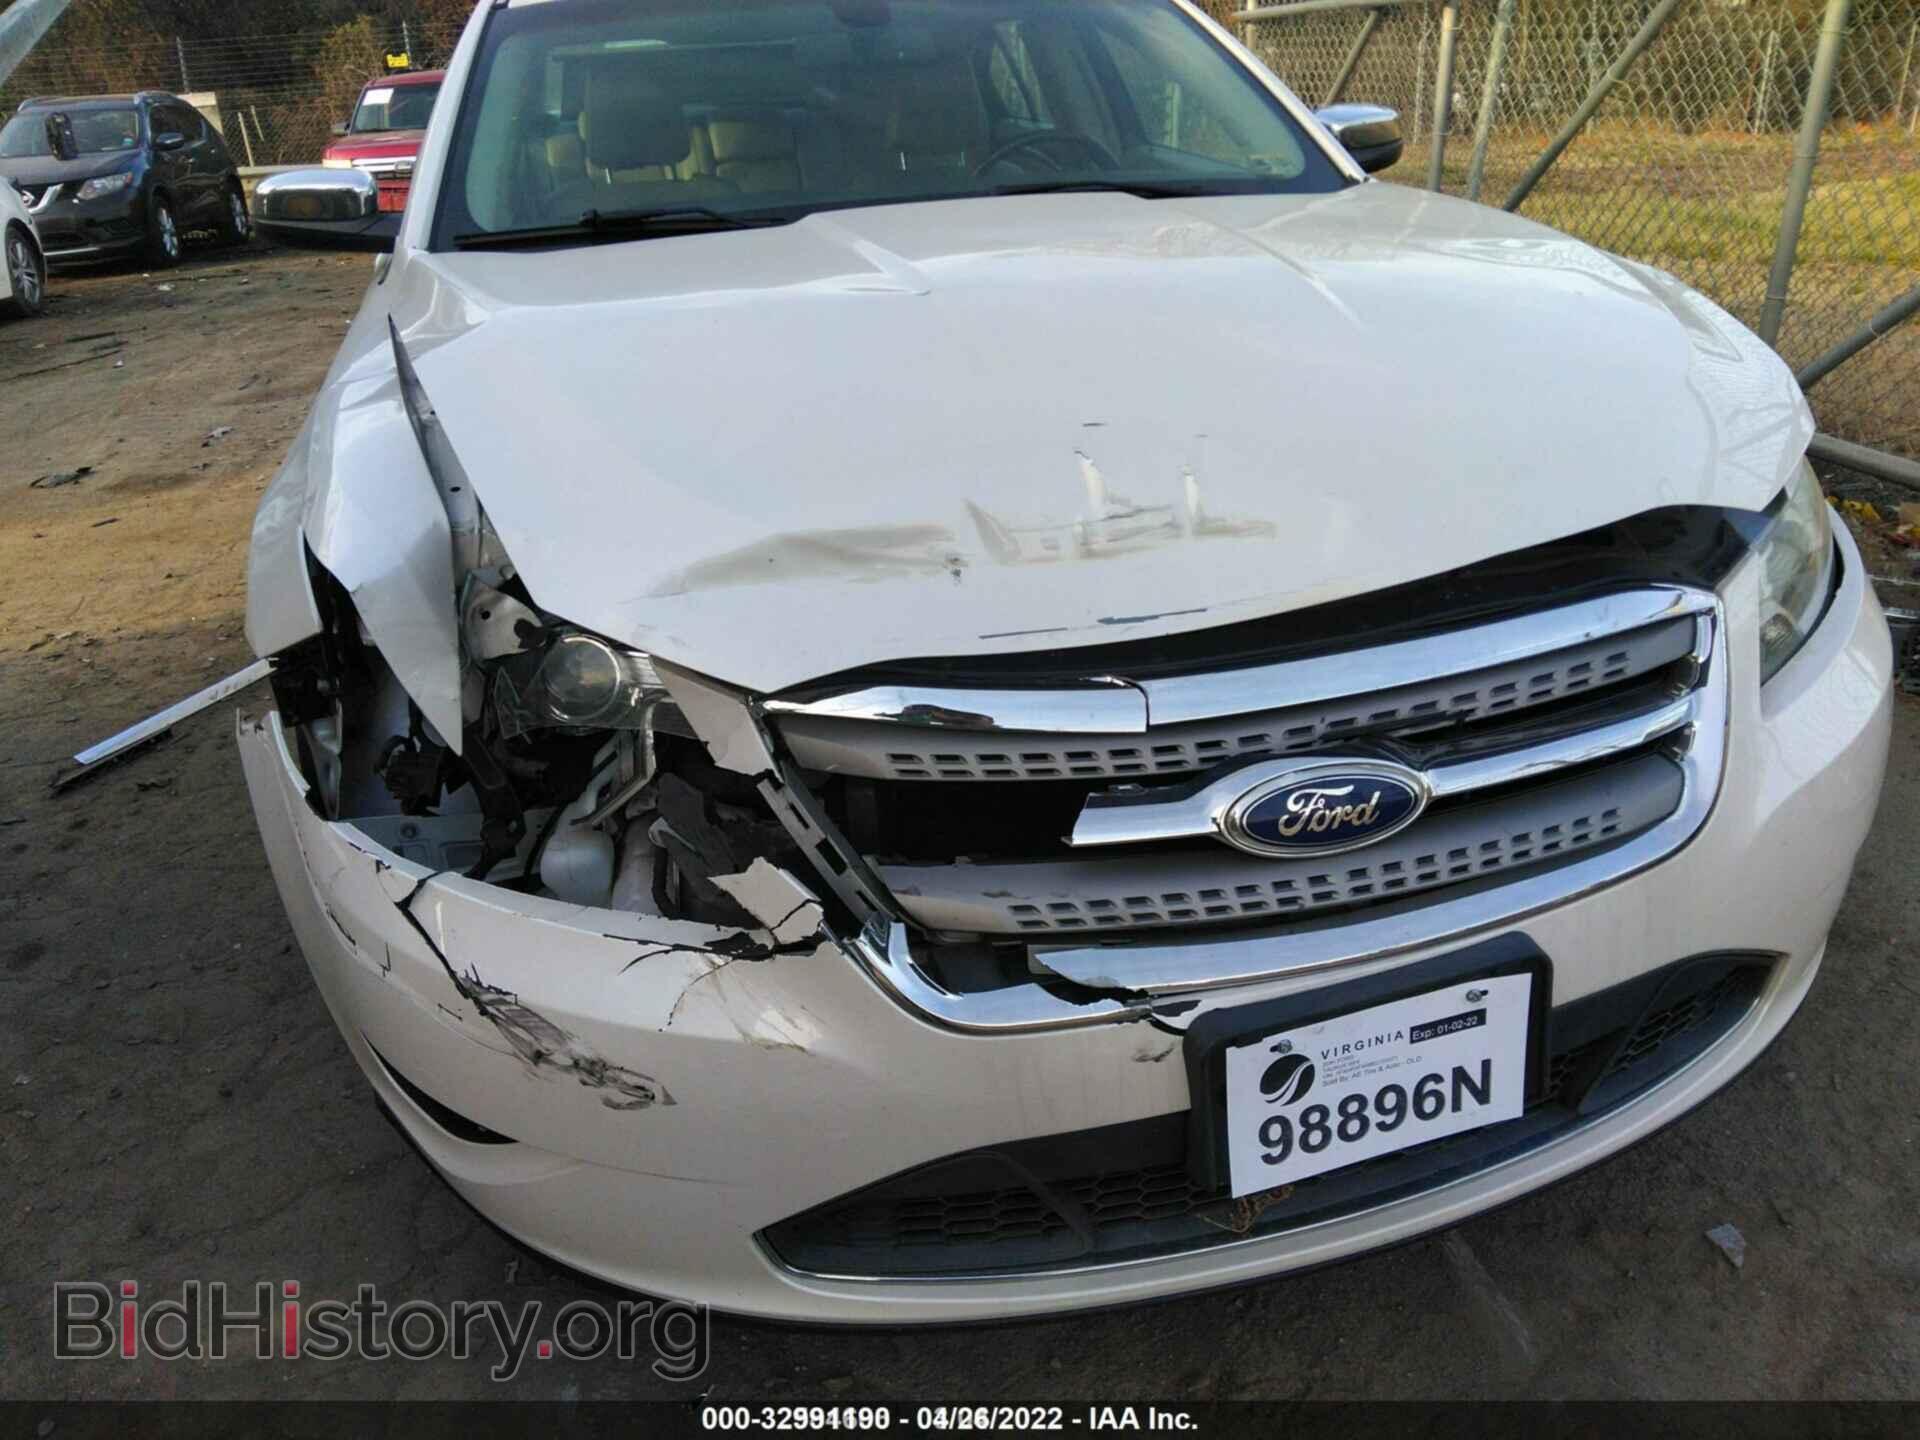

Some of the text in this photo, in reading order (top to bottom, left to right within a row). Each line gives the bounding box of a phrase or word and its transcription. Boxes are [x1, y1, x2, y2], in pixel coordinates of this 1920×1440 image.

[1278, 785, 1381, 836] Ford
[1321, 1030, 1404, 1060] VIRGINIA
[1412, 1028, 1434, 1041] Exp:
[1437, 1015, 1478, 1034] 01-02-22
[1258, 1058, 1492, 1166] 98896N
